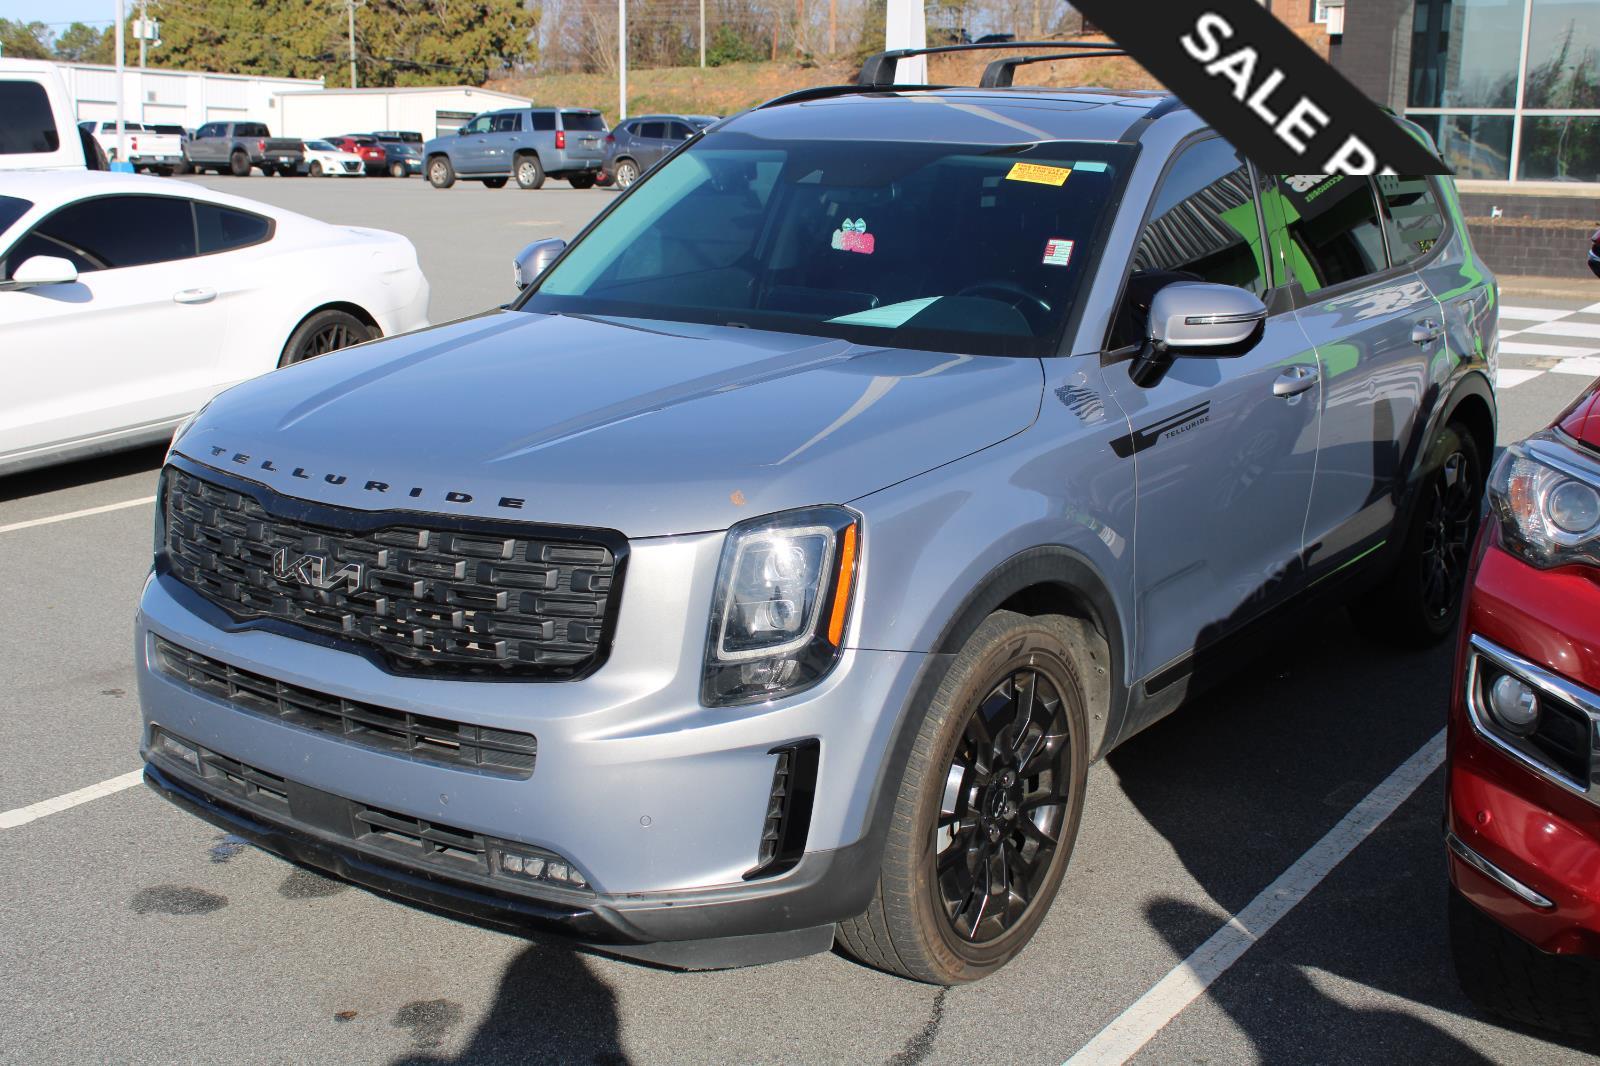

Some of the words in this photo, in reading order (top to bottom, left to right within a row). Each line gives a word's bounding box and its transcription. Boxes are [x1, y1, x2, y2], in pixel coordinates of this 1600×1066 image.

[1165, 416, 1210, 439] TELLURIDE
[211, 445, 525, 509] TELLURIDE
[274, 547, 362, 594] KIA
